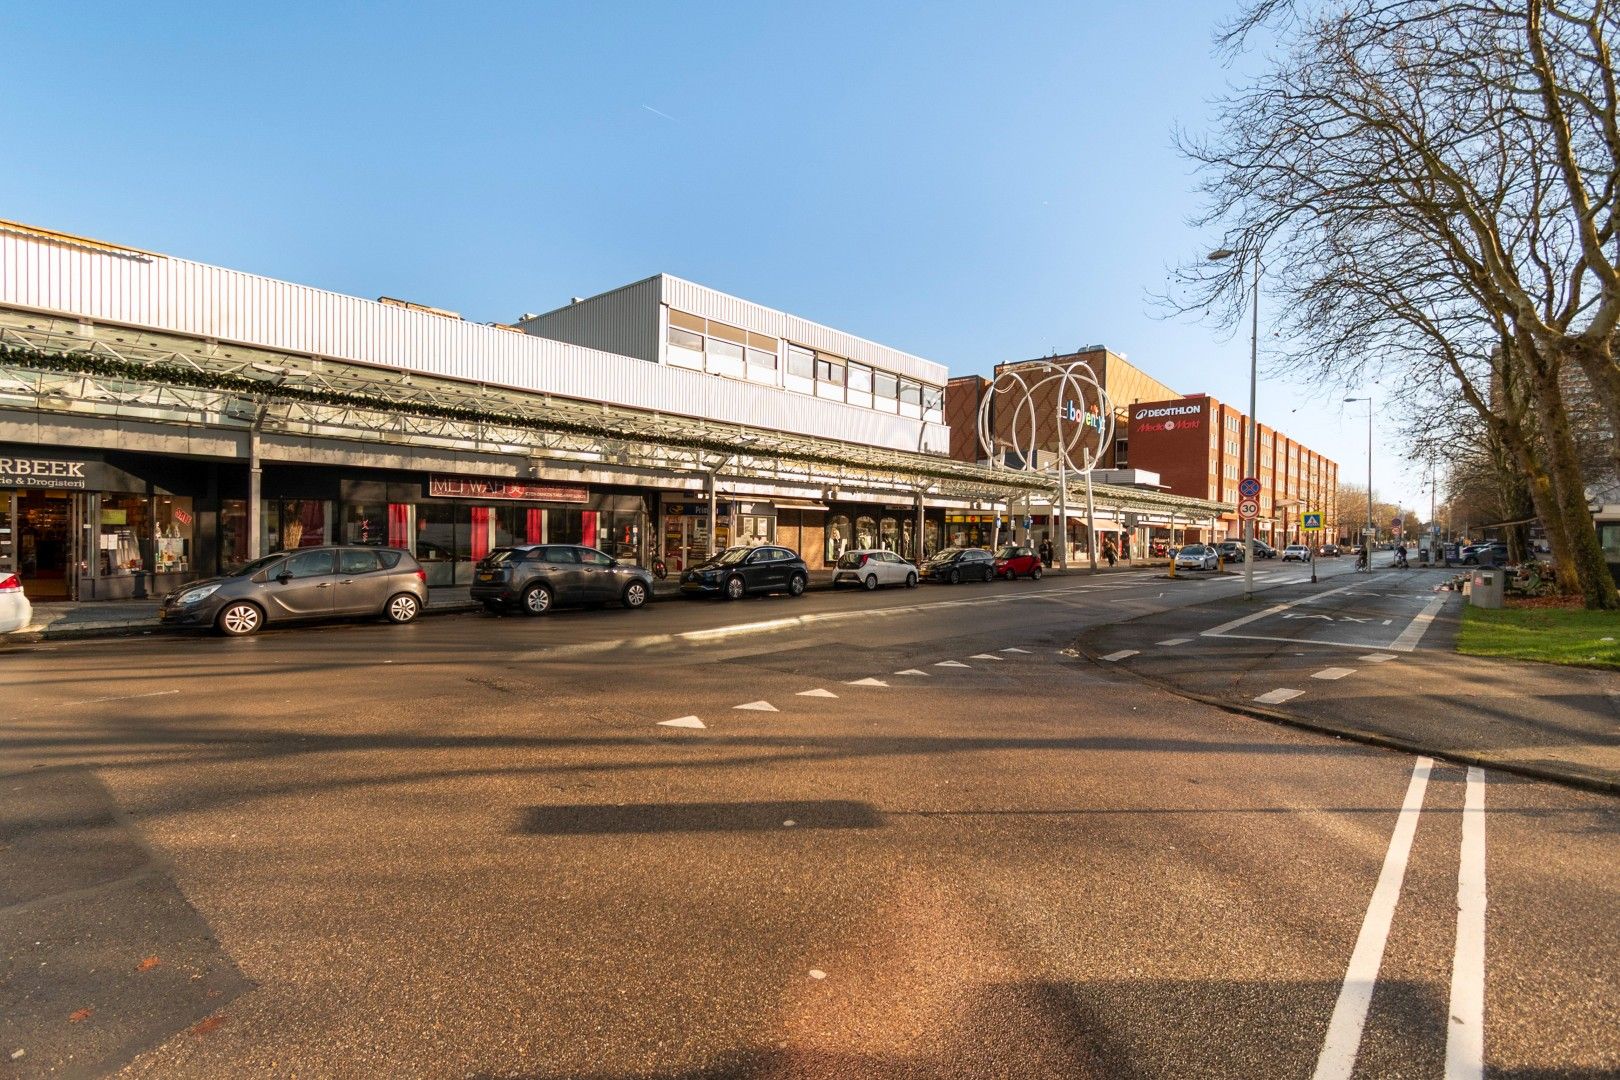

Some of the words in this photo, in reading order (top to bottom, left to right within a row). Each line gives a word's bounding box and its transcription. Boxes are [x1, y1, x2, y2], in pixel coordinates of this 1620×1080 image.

[1148, 405, 1201, 417] DECATHLON
[1137, 422, 1165, 433] Media
[1174, 418, 1200, 430] Markt
[0, 458, 85, 478] RBEEK
[0, 476, 13, 485] ie
[15, 477, 25, 485] &
[27, 477, 85, 489] Drogisterij
[1242, 504, 1257, 513] 30
